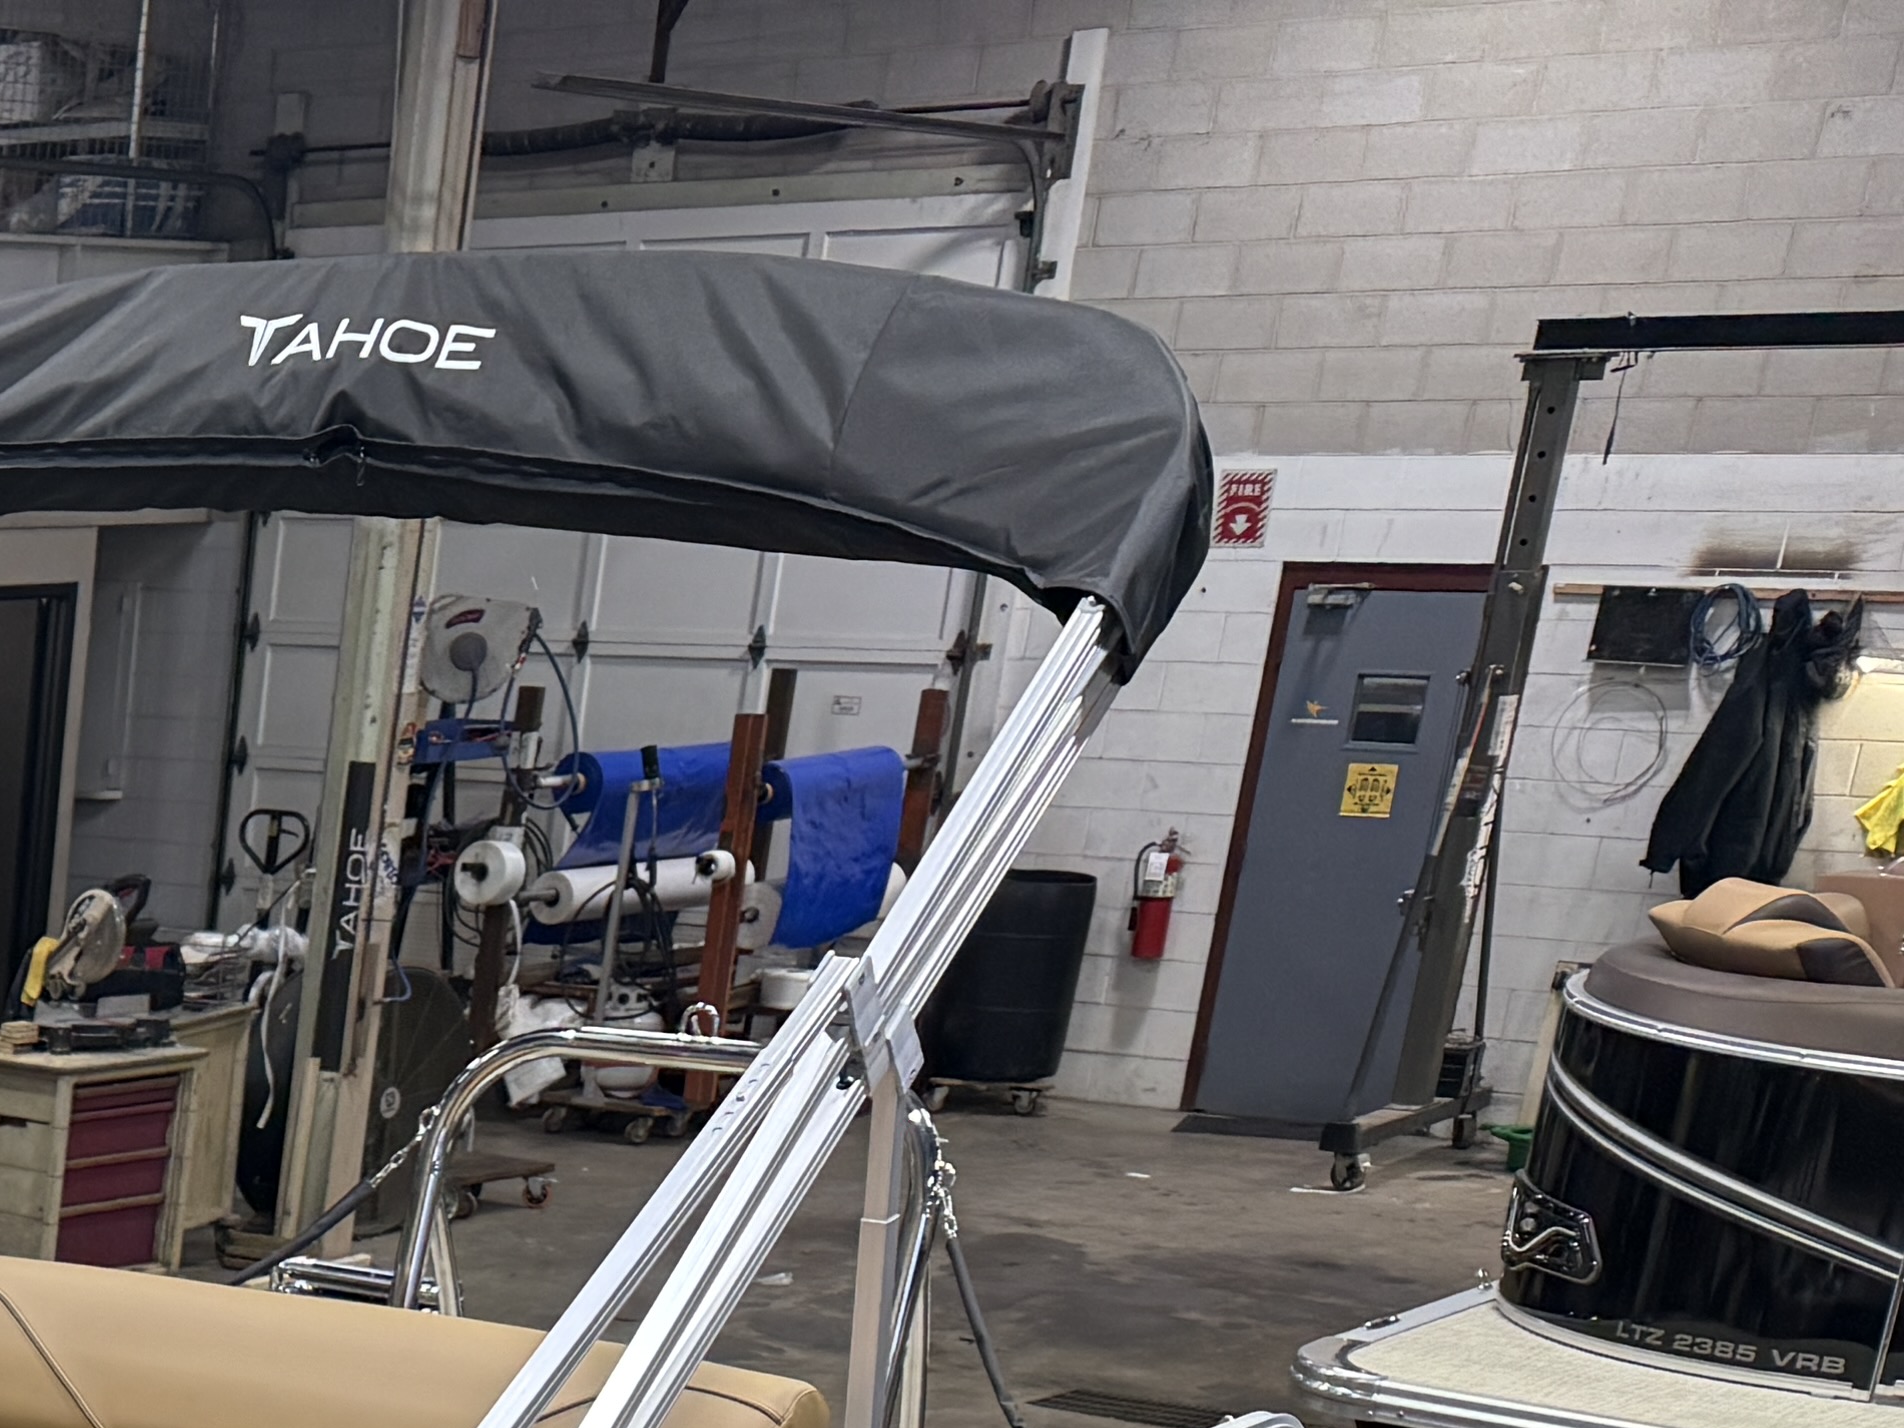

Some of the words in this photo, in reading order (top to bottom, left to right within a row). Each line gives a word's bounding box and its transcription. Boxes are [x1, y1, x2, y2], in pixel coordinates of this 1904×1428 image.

[239, 312, 497, 371] TAHOE
[1228, 483, 1262, 496] FIRE
[1615, 1320, 1666, 1346] LTZ
[1672, 1333, 1758, 1363] 2385
[1771, 1348, 1847, 1375] VRB
